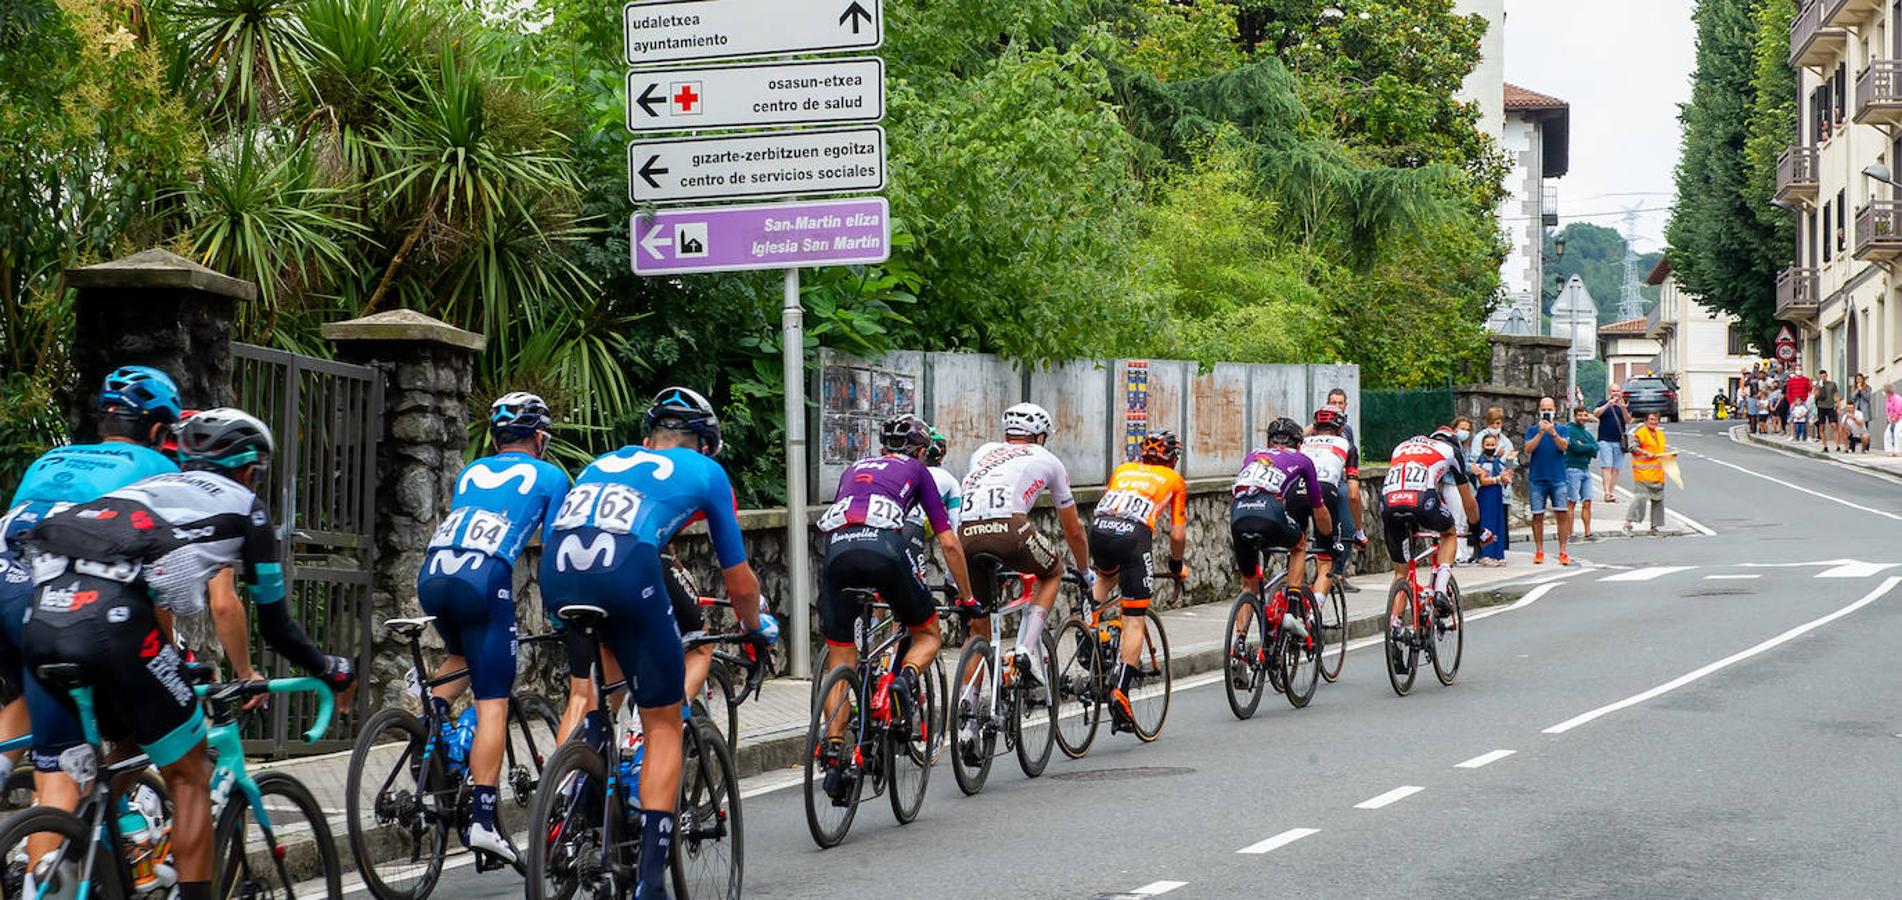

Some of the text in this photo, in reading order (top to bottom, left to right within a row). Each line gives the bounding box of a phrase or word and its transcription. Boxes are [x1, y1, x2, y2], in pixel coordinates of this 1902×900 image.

[633, 15, 700, 30] udaletxea
[634, 34, 728, 53] ayuntamiento
[768, 74, 862, 90] osasun-etxea
[753, 95, 862, 113] centro de salud
[824, 142, 875, 159] egoitza
[680, 164, 876, 188] centro de servicios sociales
[846, 213, 879, 227] eliza
[751, 240, 798, 257] Iglesia
[802, 238, 829, 252] San
[1258, 467, 1283, 487] 215
[1405, 466, 1428, 483] 227
[599, 491, 634, 524] 62
[960, 491, 975, 513] 13
[988, 487, 1006, 509] 13
[1124, 495, 1150, 518] 181
[872, 500, 902, 526] 212
[469, 519, 502, 546] 64
[963, 521, 1009, 537] CITROËN
[1099, 520, 1136, 533] EUSKADI
